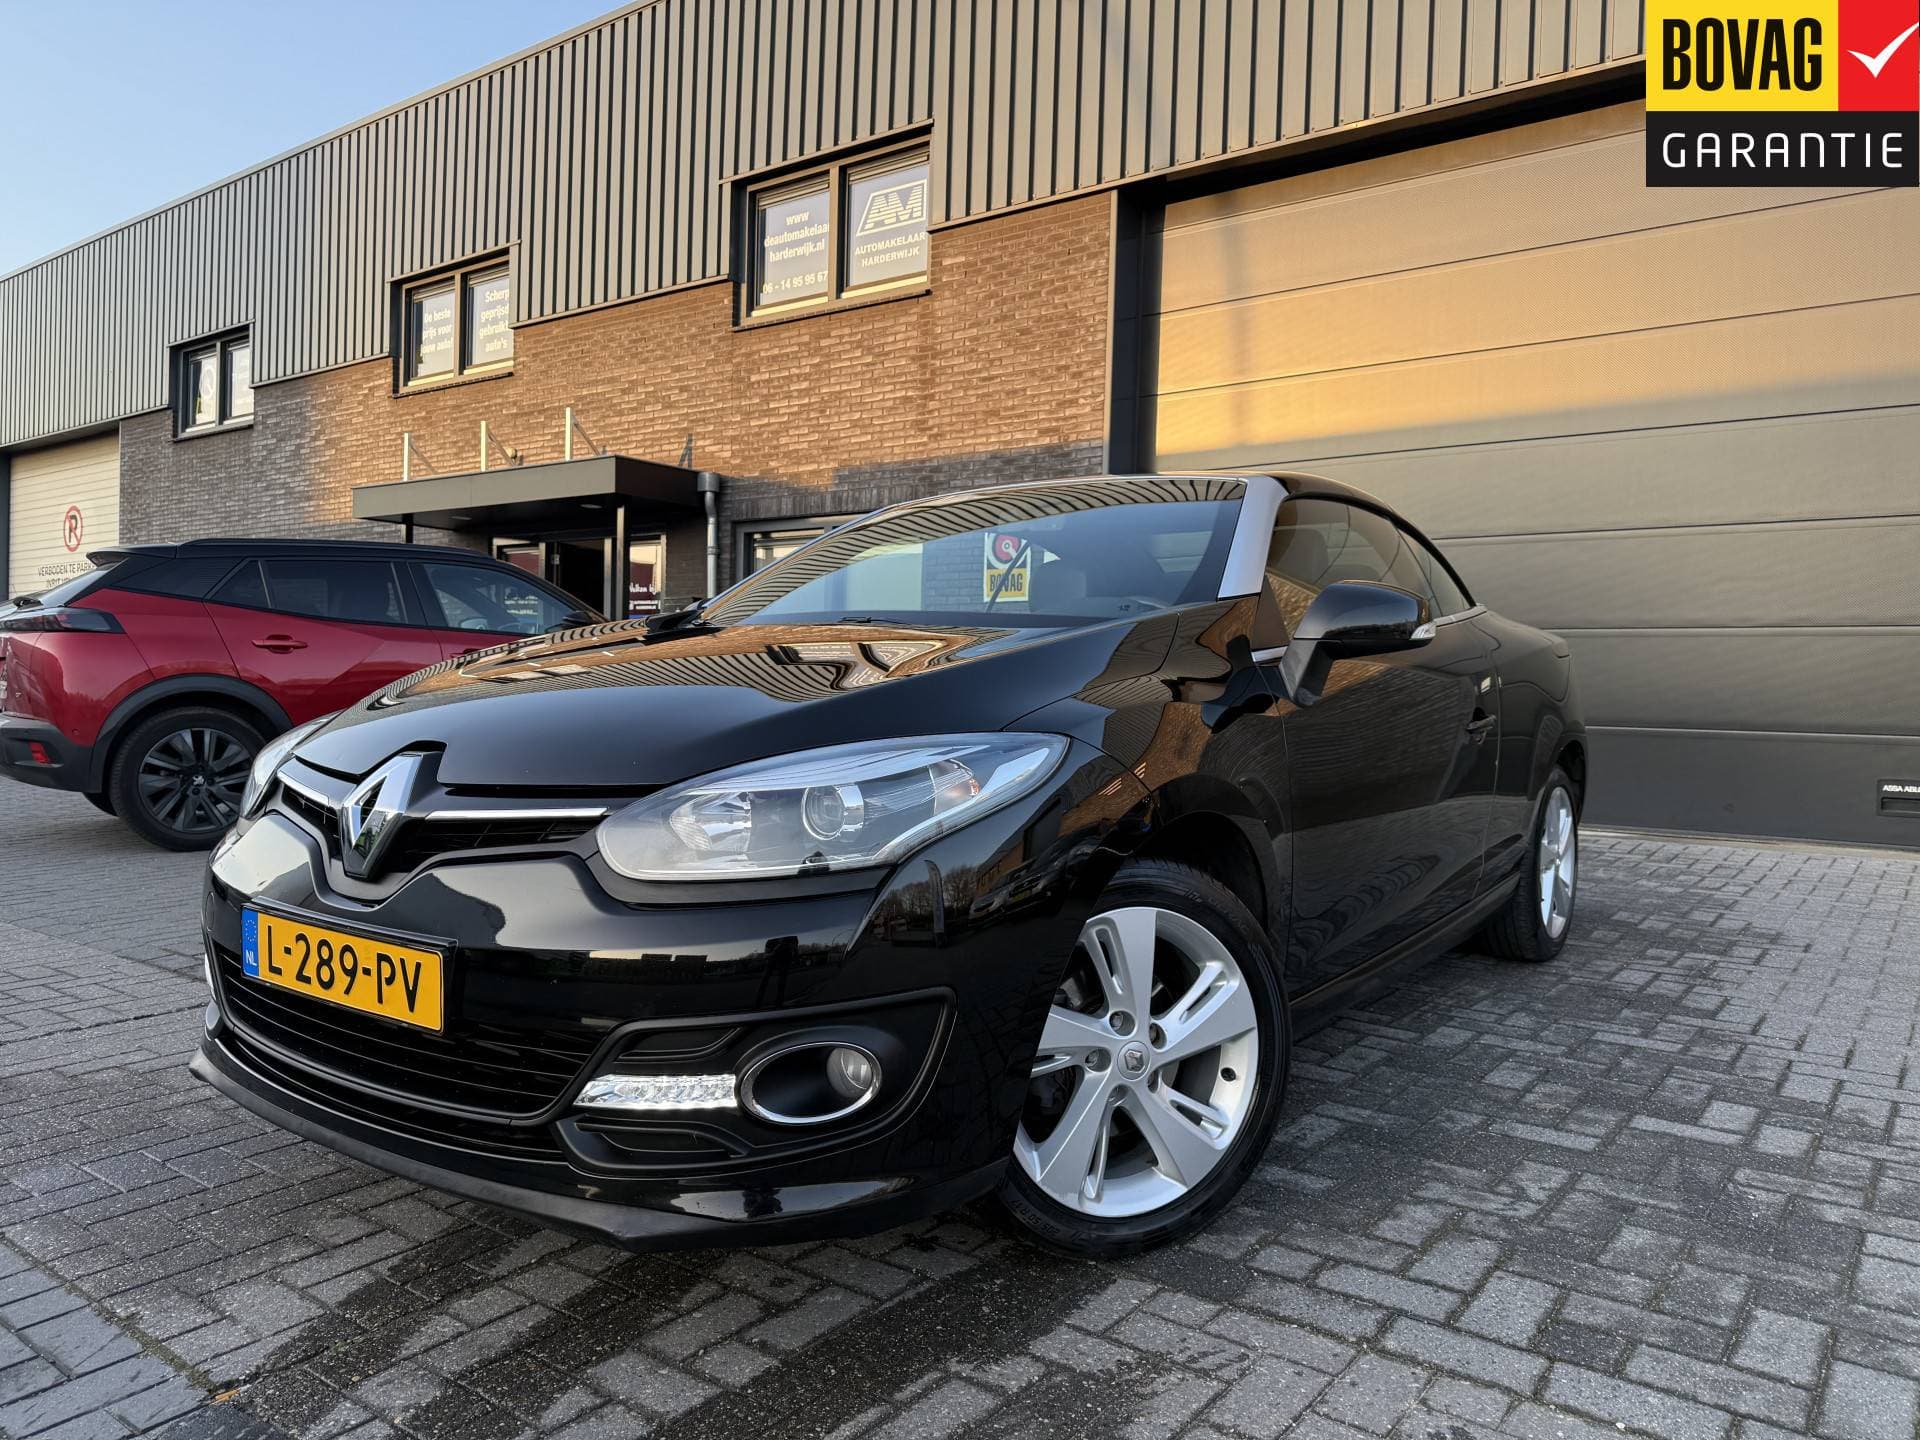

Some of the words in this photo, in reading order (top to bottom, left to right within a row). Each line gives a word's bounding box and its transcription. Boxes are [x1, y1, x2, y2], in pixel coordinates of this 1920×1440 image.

[785, 212, 810, 226] www
[769, 239, 825, 262] harderwijk.nl
[855, 231, 926, 256] AUTOMAKELAAR
[862, 246, 921, 268] HARDERWIJK
[763, 282, 774, 294] 06
[781, 278, 791, 291] 14
[793, 275, 804, 289] 95
[805, 273, 816, 286] 95
[38, 563, 68, 577] VERBODEN
[69, 563, 76, 574] TE
[245, 949, 257, 967] NL
[267, 925, 422, 1013] L-289-PV
